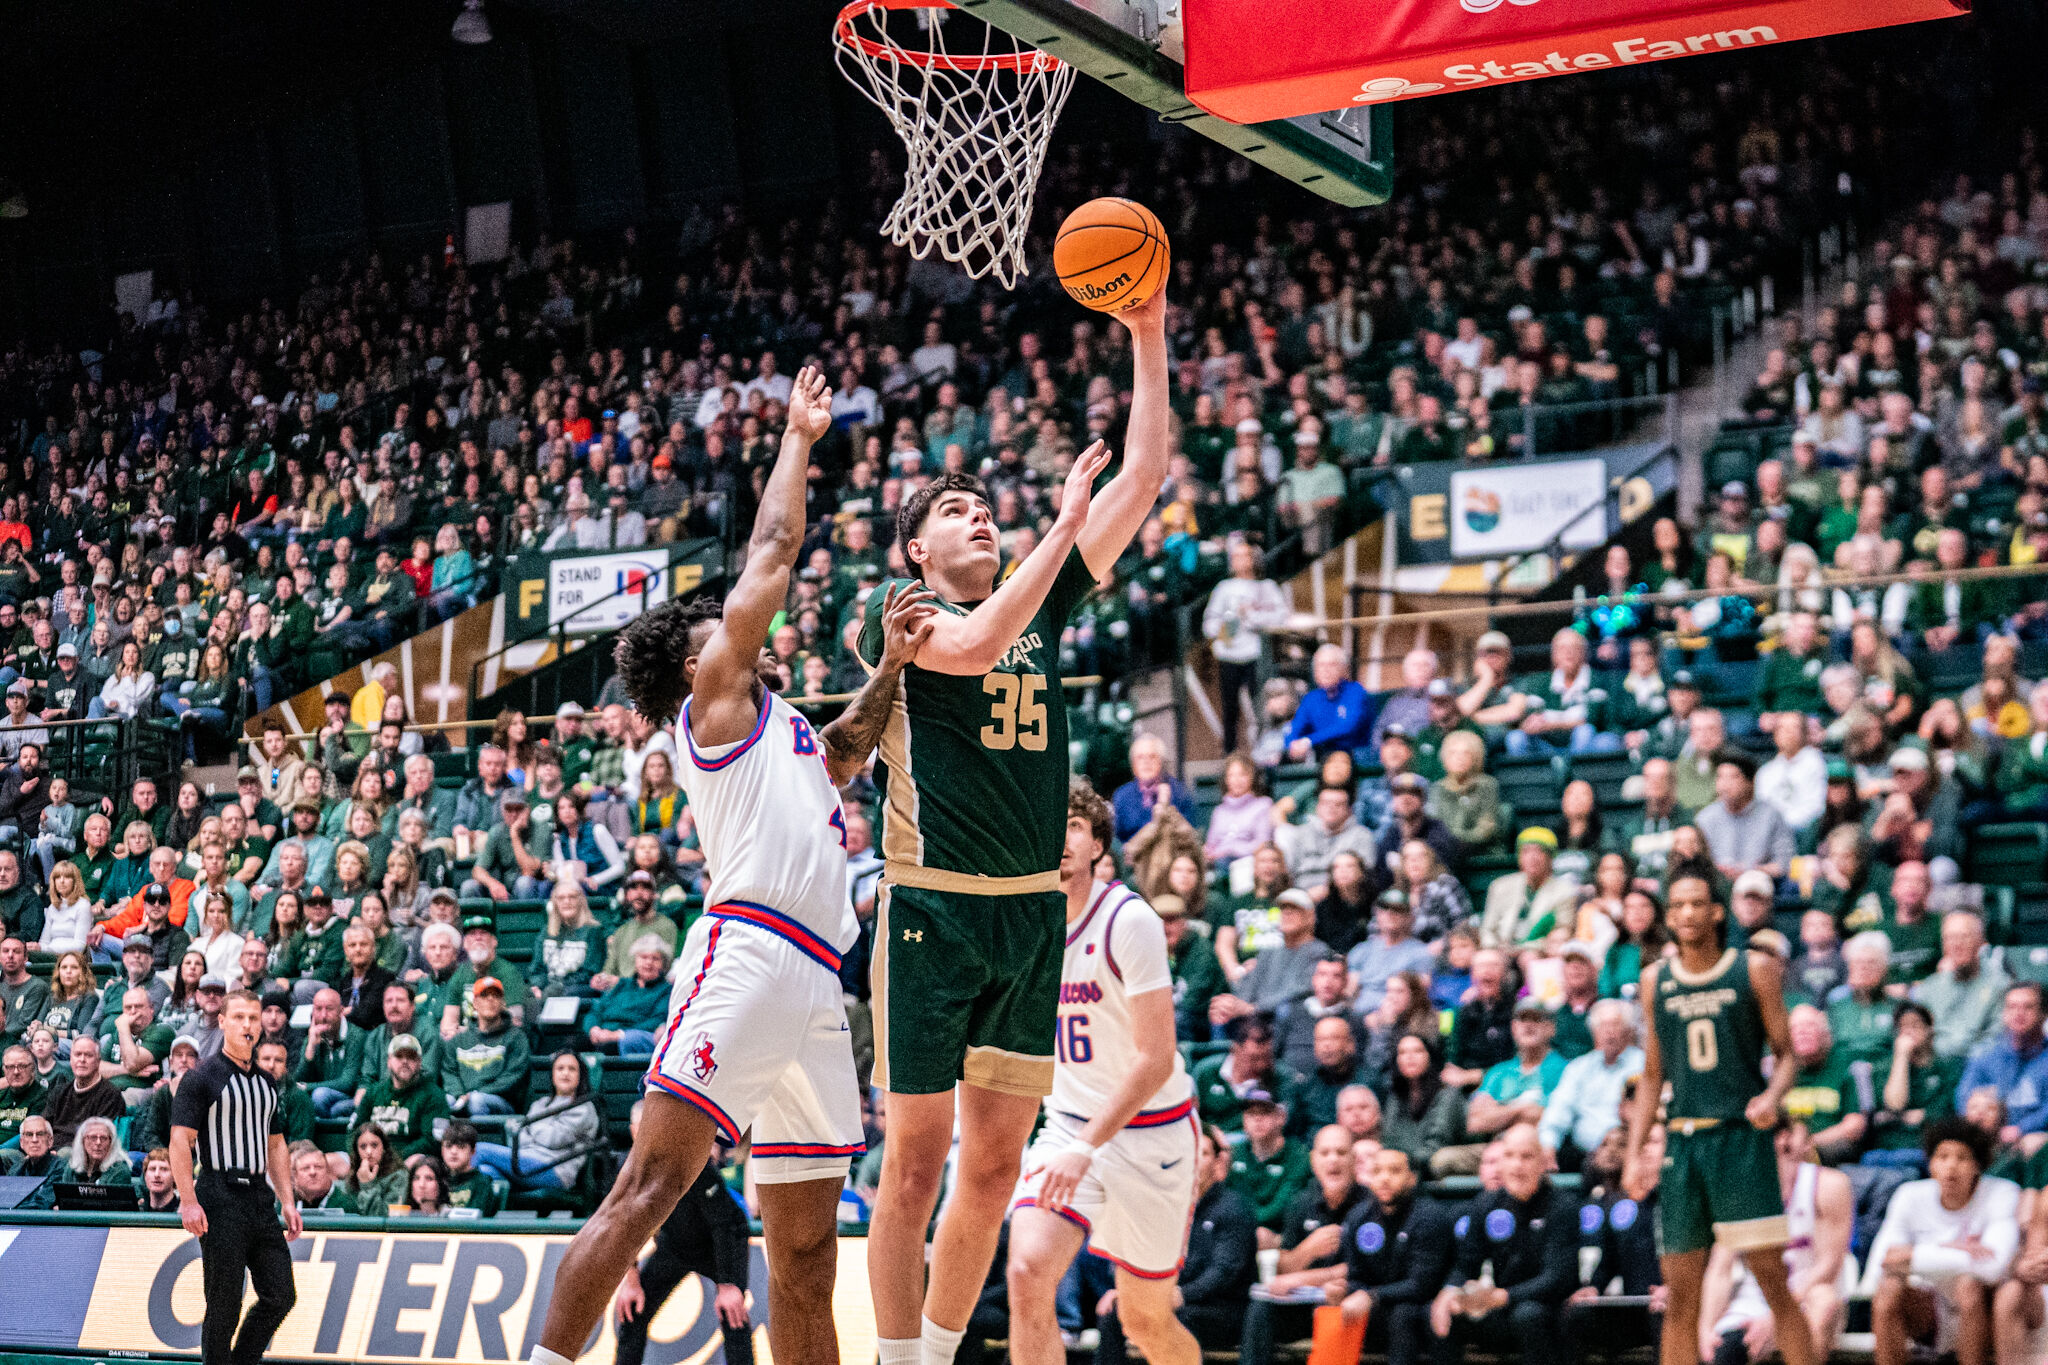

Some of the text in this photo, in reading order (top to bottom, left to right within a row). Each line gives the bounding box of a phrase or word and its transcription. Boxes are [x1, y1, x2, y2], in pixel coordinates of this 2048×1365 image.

[1612, 25, 1779, 64] Farm
[1409, 493, 1446, 541] E
[558, 566, 601, 583] STAND
[519, 579, 545, 618] F
[558, 589, 583, 605] FOR
[980, 672, 1048, 751] 35
[1056, 1013, 1094, 1063] 16
[1687, 1018, 1719, 1072] 0
